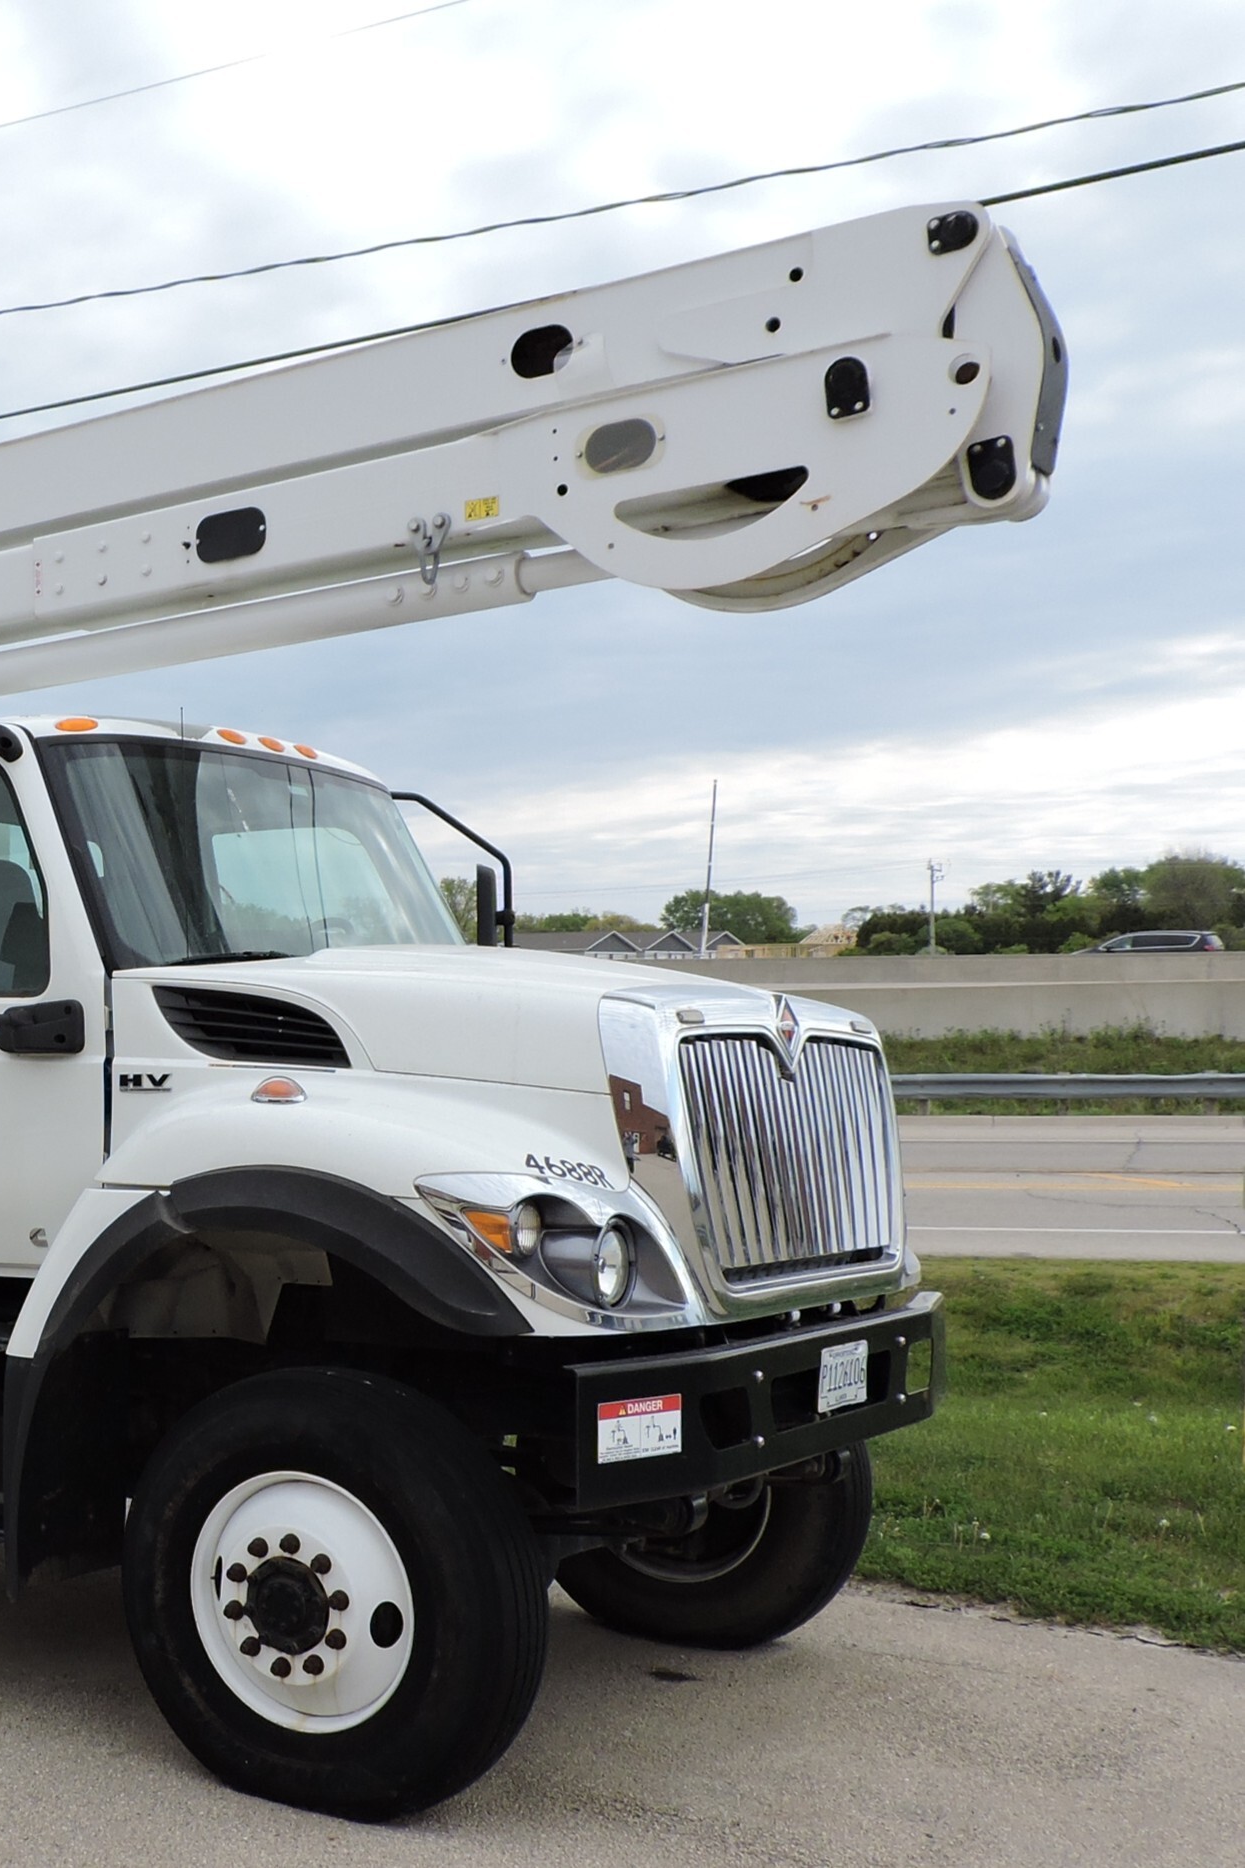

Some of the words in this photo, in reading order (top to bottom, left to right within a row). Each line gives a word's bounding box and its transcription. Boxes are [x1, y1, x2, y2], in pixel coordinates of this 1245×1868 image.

[119, 1073, 172, 1087] HV
[525, 1153, 615, 1190] 4688R
[627, 1400, 663, 1414] DANGER
